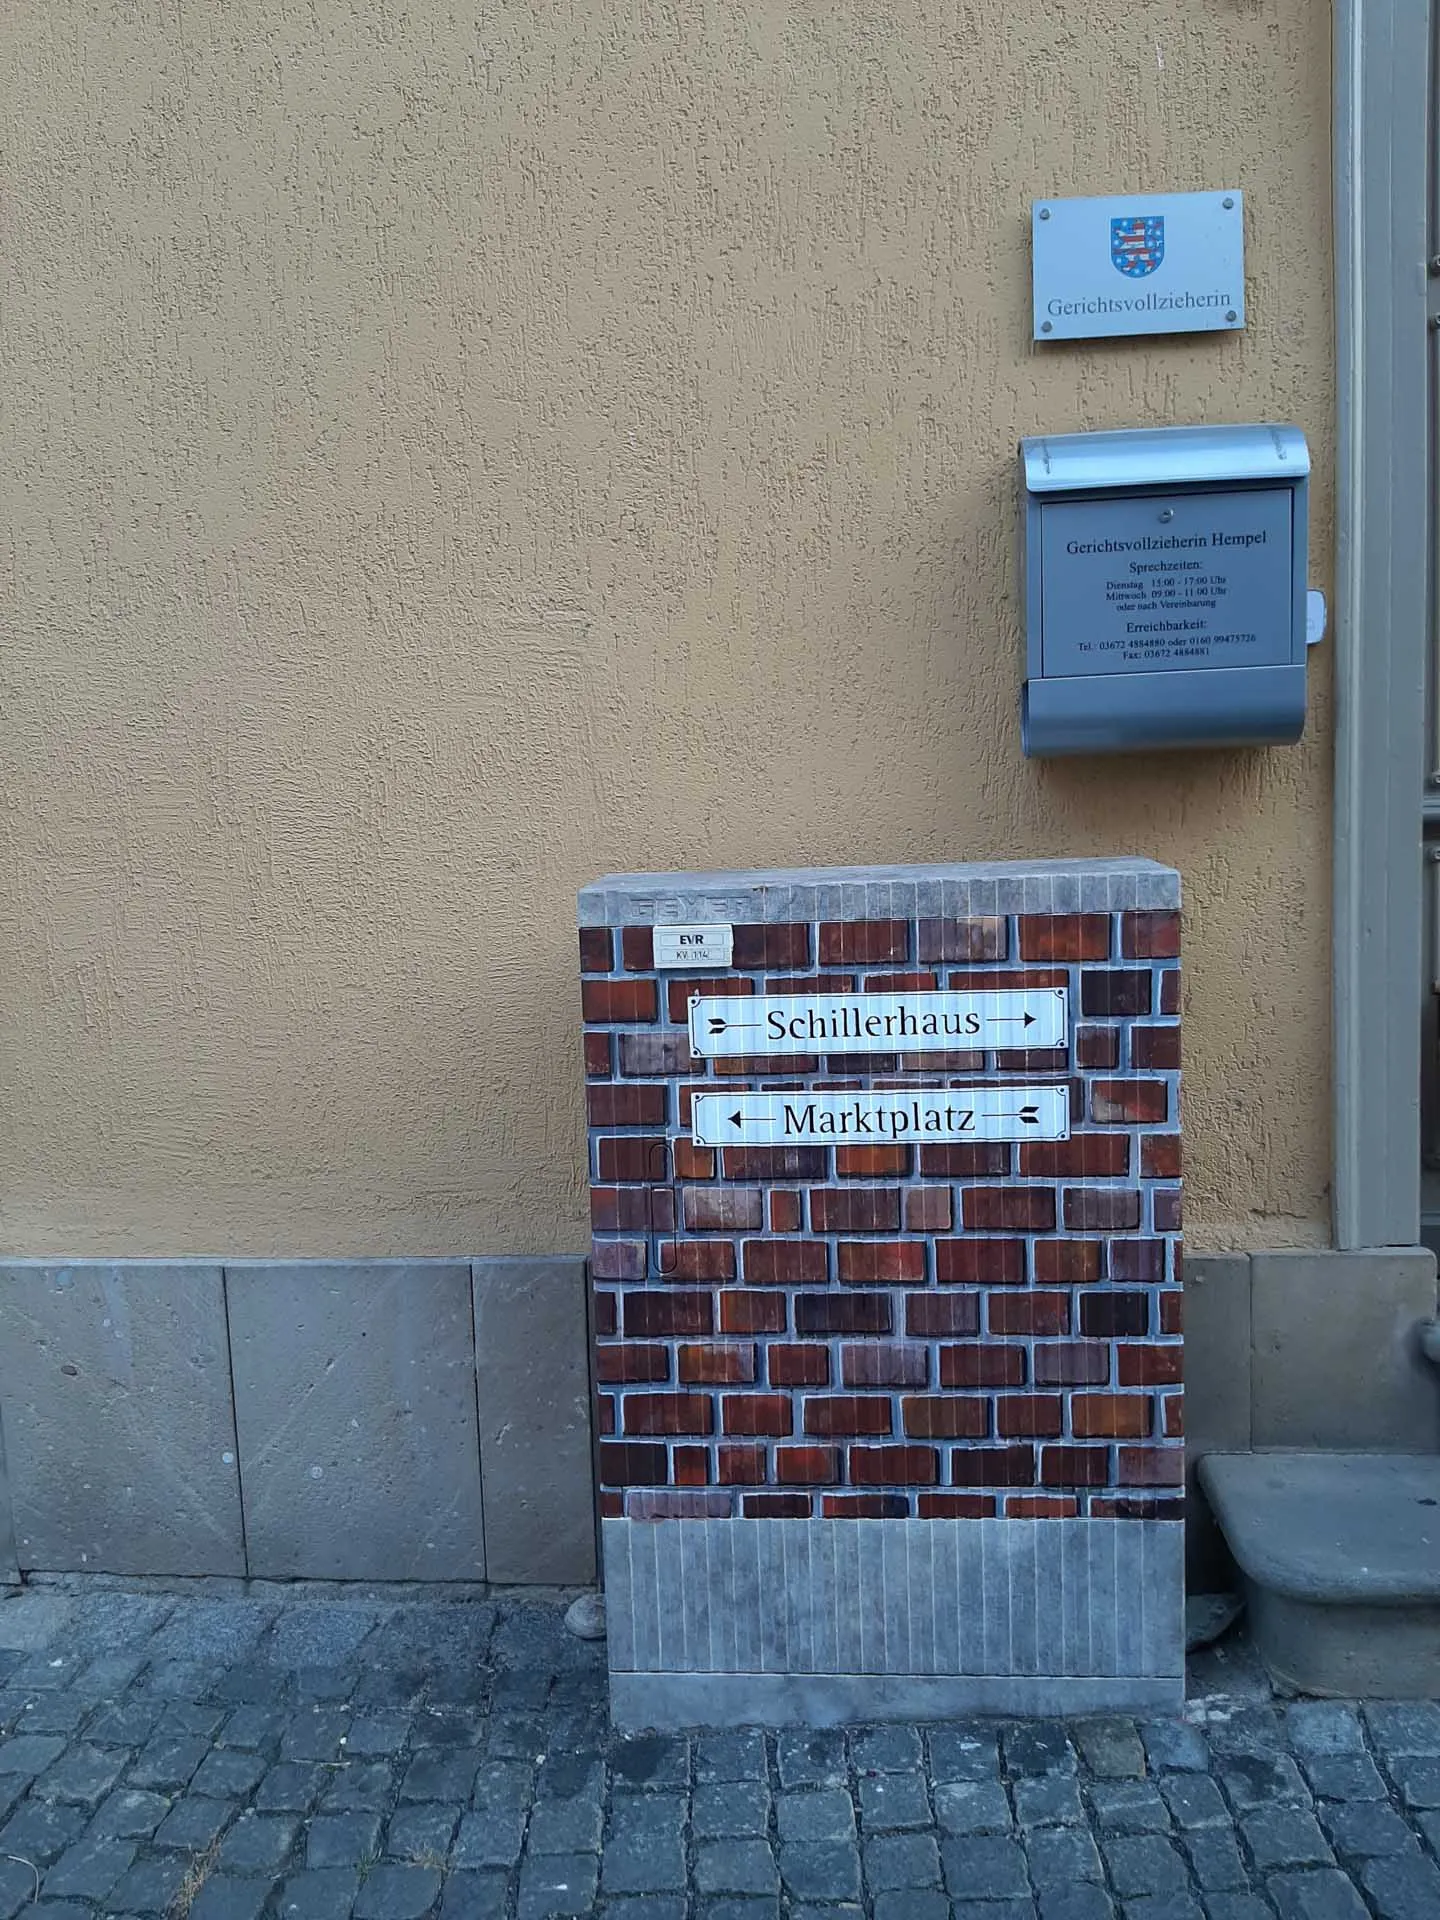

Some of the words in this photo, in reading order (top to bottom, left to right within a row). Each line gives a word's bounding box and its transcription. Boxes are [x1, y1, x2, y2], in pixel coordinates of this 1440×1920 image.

[1048, 290, 1231, 316] Gerichtsvollzieherin
[1066, 536, 1208, 554] Gerichtsvollzieherin
[1212, 530, 1267, 548] Hempel
[1129, 560, 1203, 574] Sprechzeiten:
[1106, 580, 1144, 590] Dienstag
[1210, 576, 1226, 584] Uhr
[1106, 592, 1146, 601] Mittwoch
[1152, 590, 1175, 598] 09:00
[1210, 586, 1227, 596] Uhr
[1116, 602, 1136, 612] oder
[1138, 600, 1158, 610] nach
[1160, 598, 1216, 610] Vereinbarung
[1126, 620, 1207, 633] Erreichbarkeit:
[1099, 640, 1126, 650] 03672
[1168, 638, 1187, 647] oder
[1190, 636, 1212, 646] 0160
[1123, 650, 1142, 660] Fax:
[1144, 648, 1170, 658] 03672
[679, 934, 705, 945] EVR
[767, 1006, 981, 1040] Schillerhaus
[783, 1102, 975, 1138] Marktplatz
